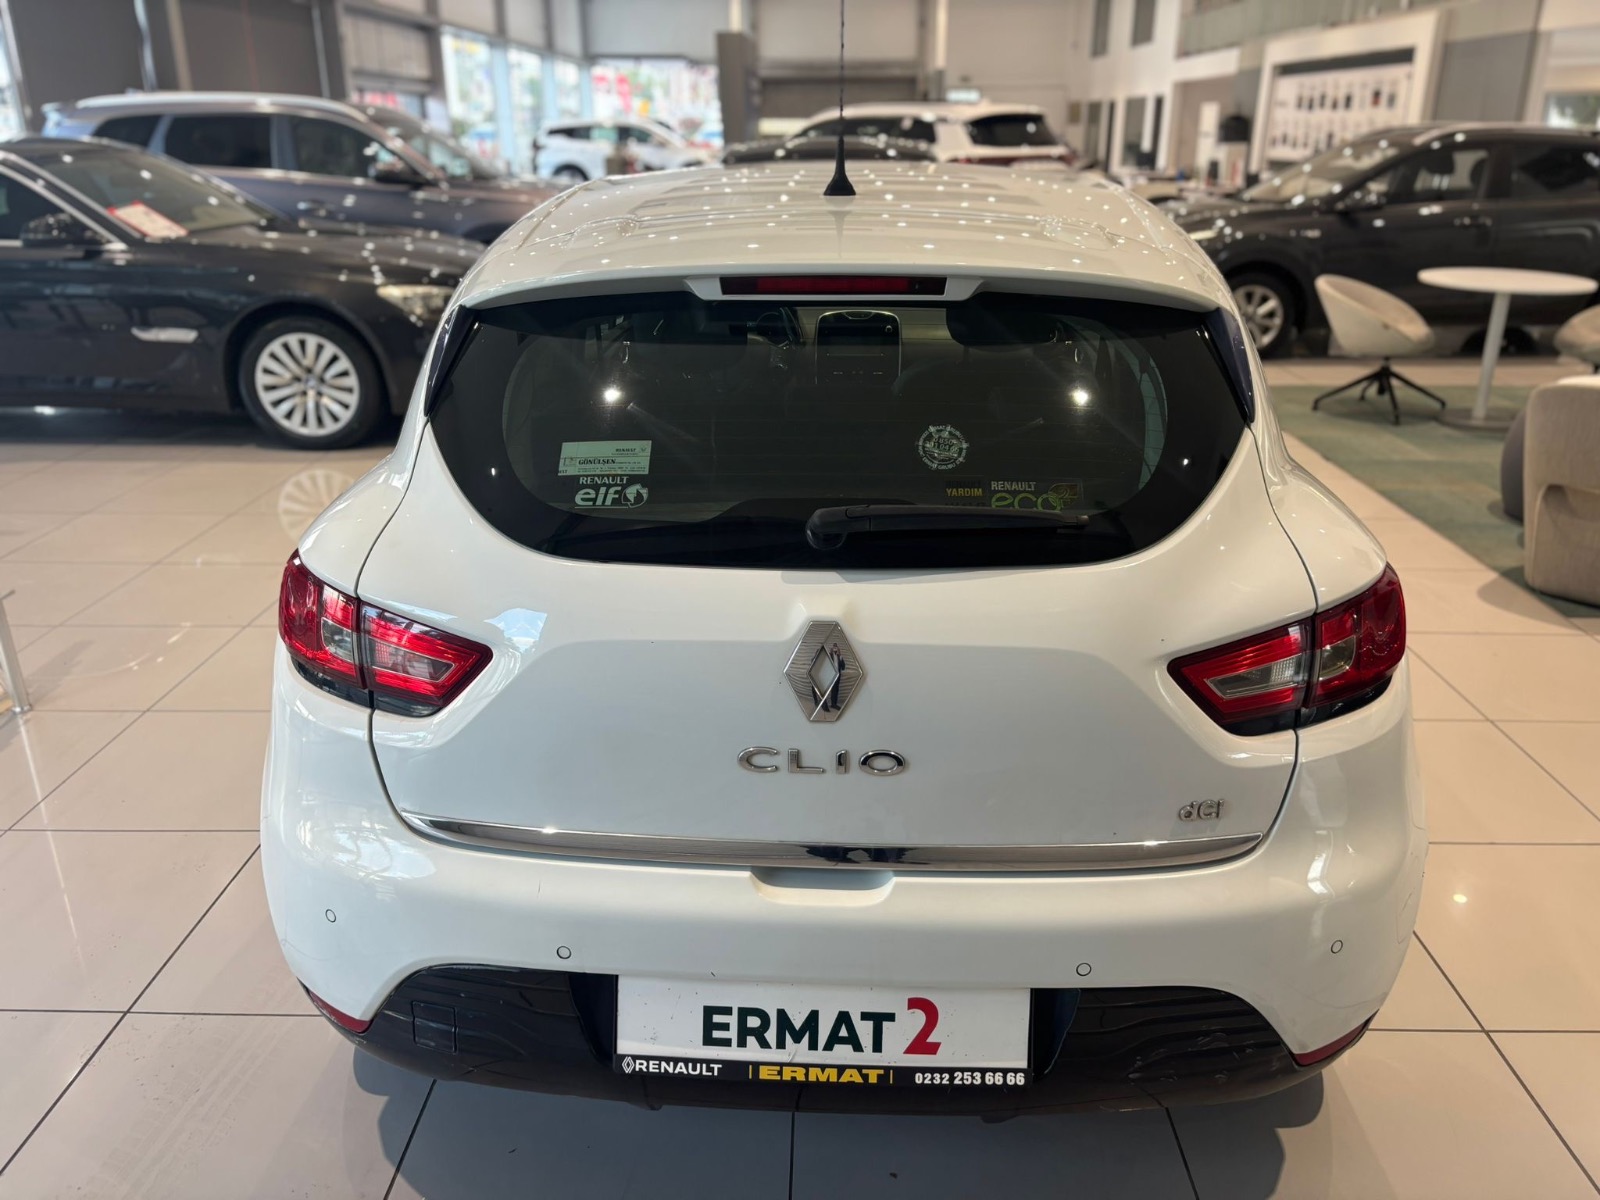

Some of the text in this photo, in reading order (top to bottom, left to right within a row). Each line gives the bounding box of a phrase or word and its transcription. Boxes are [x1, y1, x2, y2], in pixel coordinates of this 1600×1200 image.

[579, 476, 629, 485] RENAULT
[990, 480, 1037, 491] RENAULT
[574, 486, 622, 506] elf
[945, 487, 983, 497] YARDIM
[737, 746, 906, 777] CLIO
[701, 996, 942, 1056] ERMAT 2
[634, 1058, 722, 1077] RENAULT
[758, 1064, 885, 1084] ERMAT
[914, 1070, 1026, 1086] 0232 253 66 66
